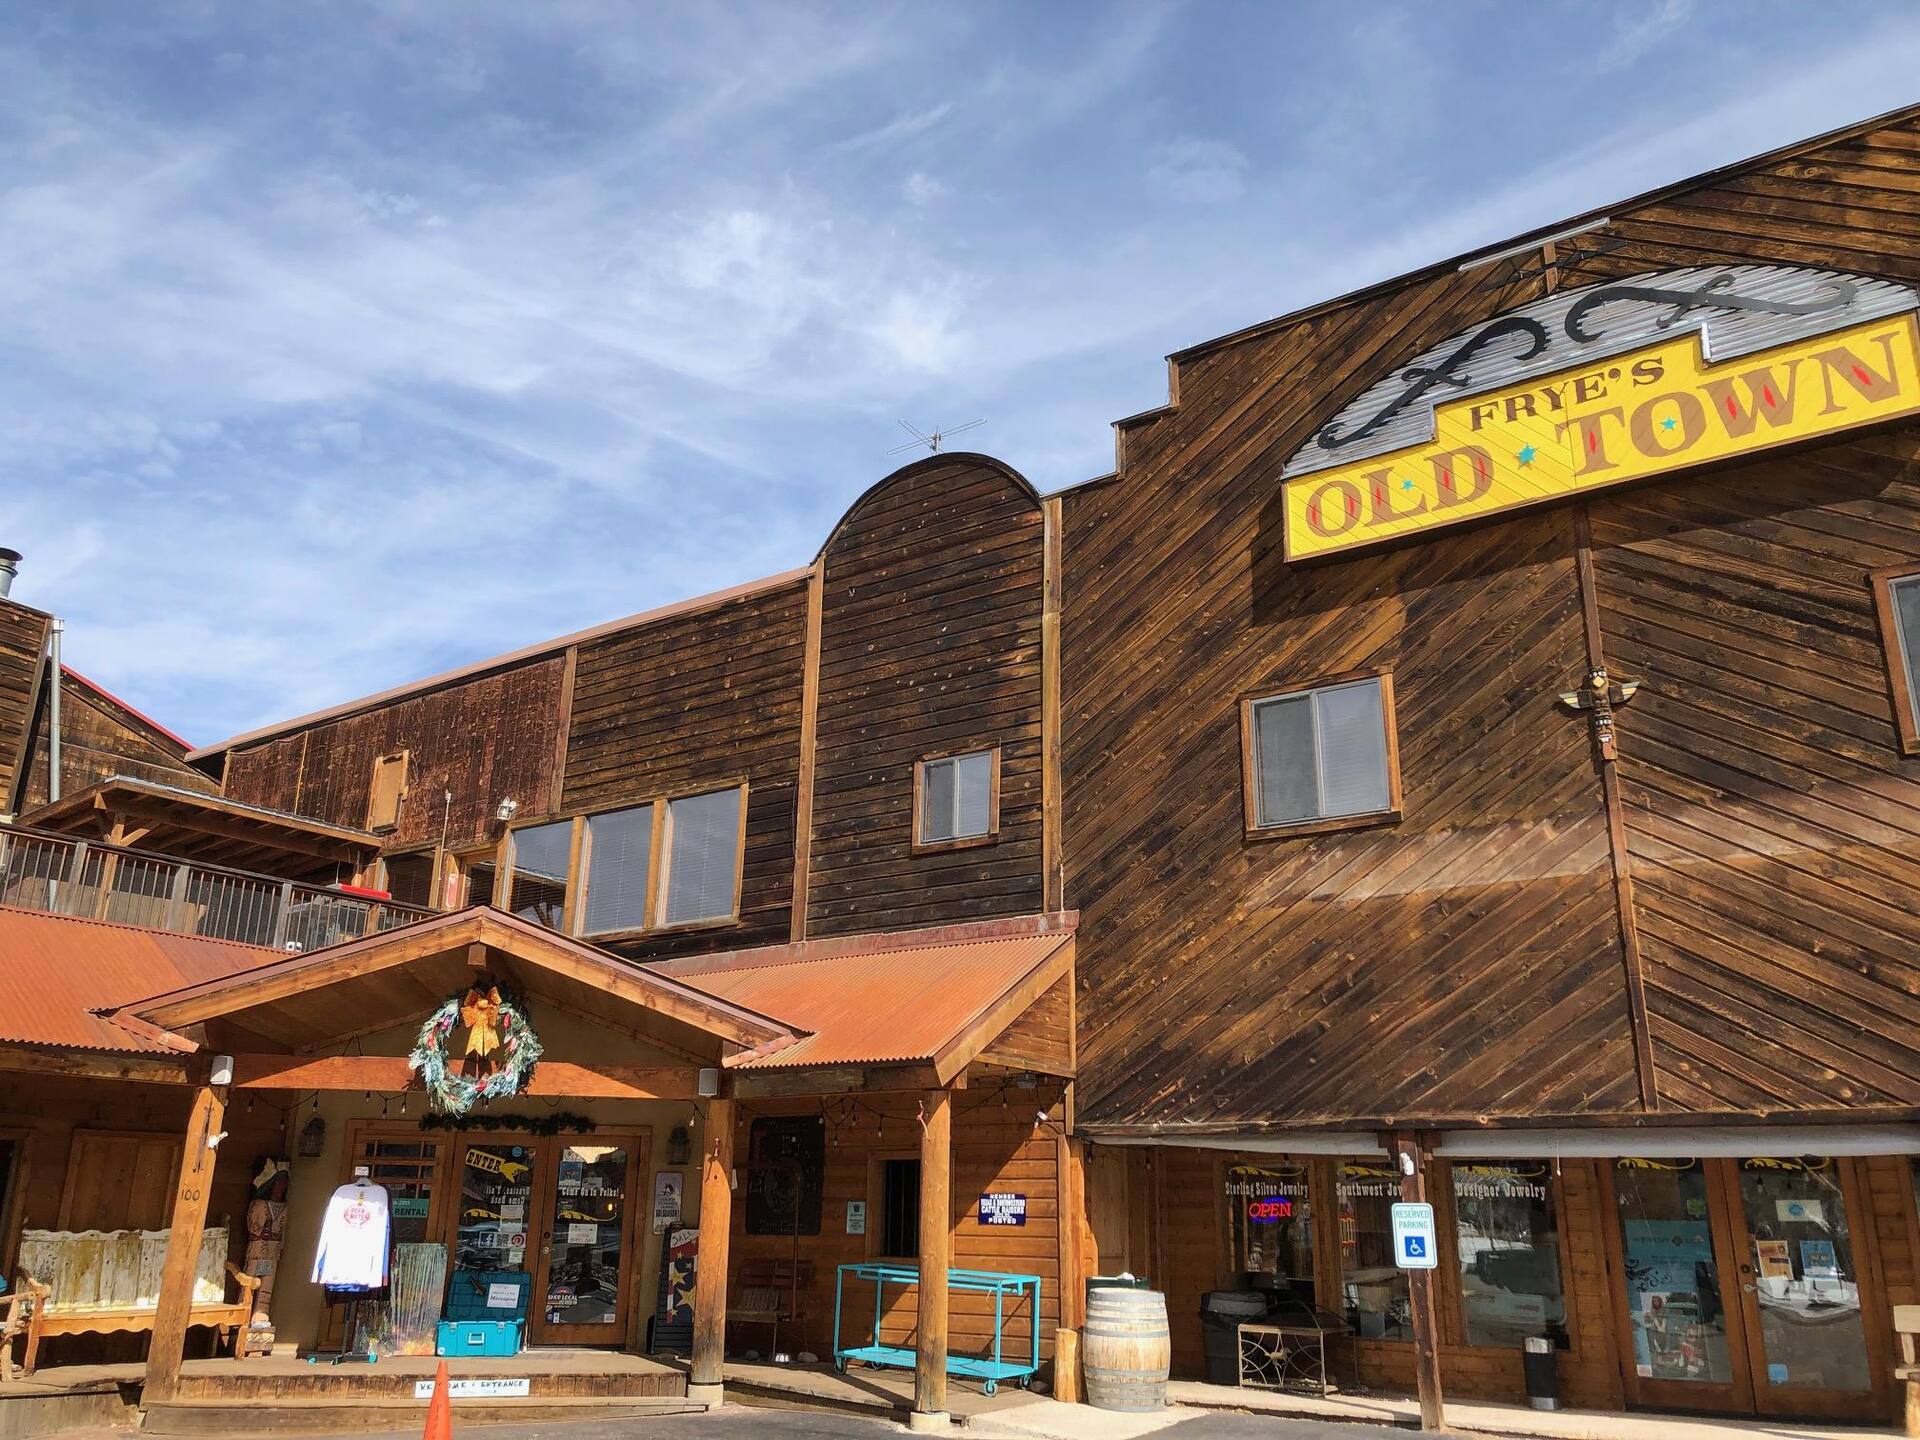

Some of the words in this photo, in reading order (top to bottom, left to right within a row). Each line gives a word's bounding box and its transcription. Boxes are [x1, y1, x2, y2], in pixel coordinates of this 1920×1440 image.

[1469, 357, 1665, 432] FRYE'S
[1305, 444, 1496, 538] OLD
[1555, 331, 1900, 477] TOWN
[466, 1151, 501, 1173] ENTER
[181, 1189, 200, 1201] 100
[580, 1187, 588, 1197] On
[590, 1187, 597, 1197] In
[1225, 1182, 1255, 1198] Sterling
[1255, 1182, 1278, 1196] Silver
[1279, 1182, 1309, 1199] Jewelry
[1335, 1182, 1383, 1197] Southwest
[1455, 1182, 1500, 1200] Designer
[1504, 1182, 1546, 1201] Jewelry
[395, 1208, 426, 1216] RENTAL
[1248, 1202, 1292, 1217] OPEN
[1395, 1209, 1430, 1218] RESERVED
[1398, 1220, 1429, 1229] PARKING
[481, 1380, 523, 1388] ENTRANCE
